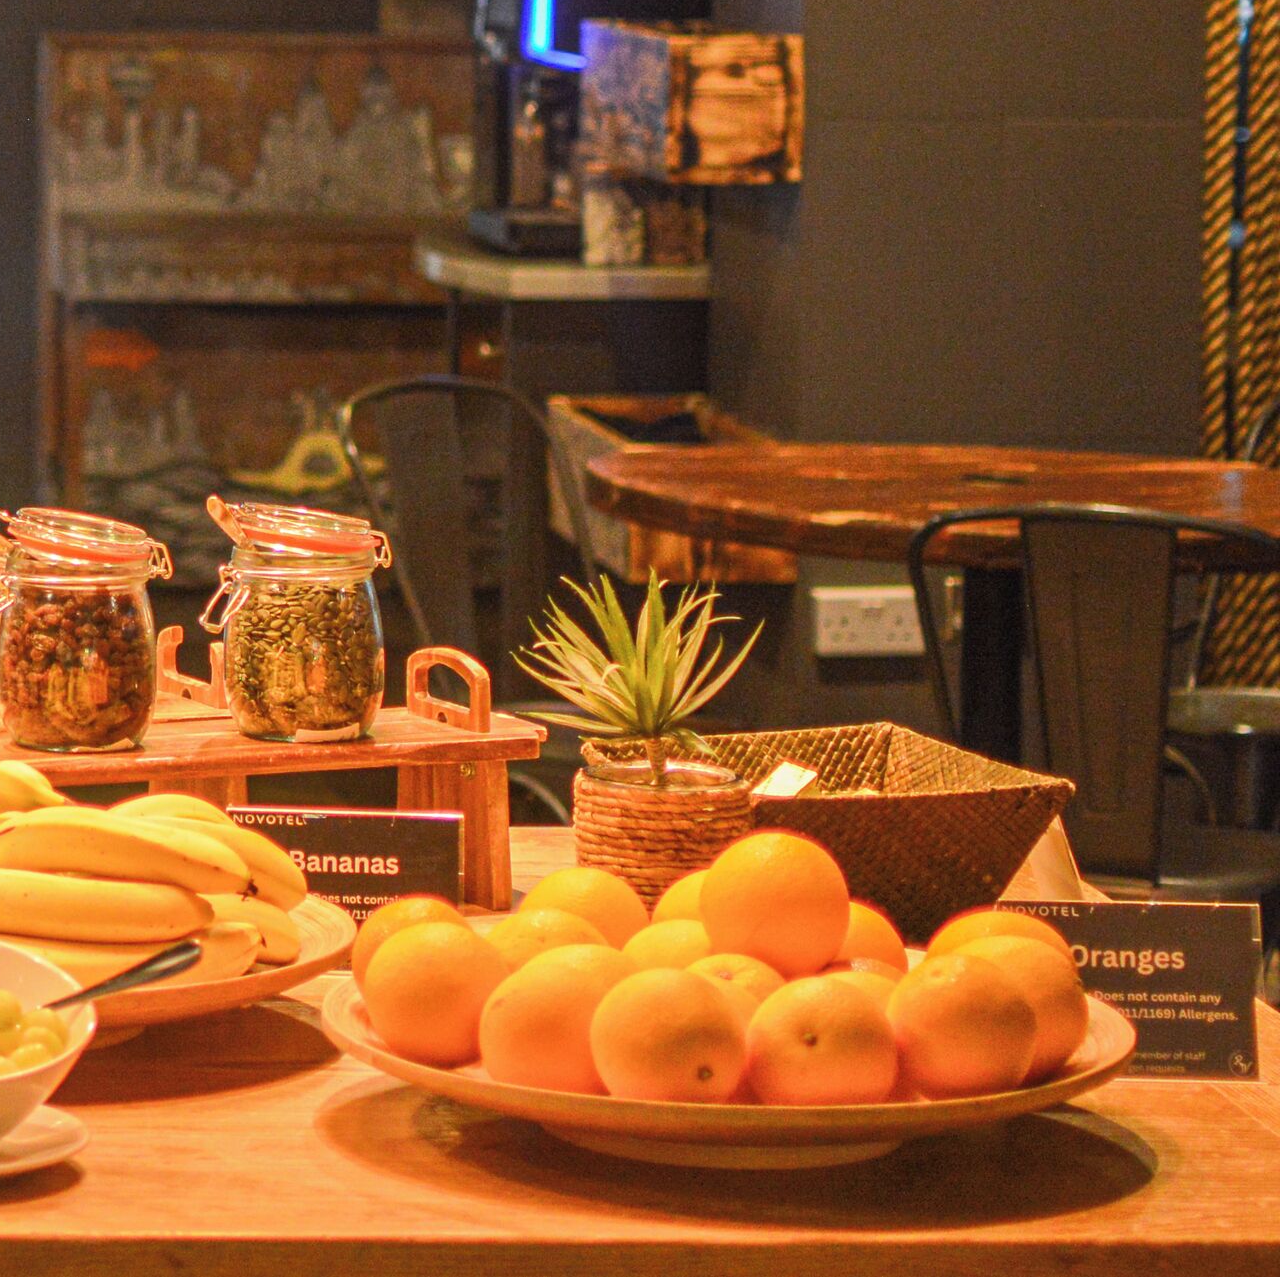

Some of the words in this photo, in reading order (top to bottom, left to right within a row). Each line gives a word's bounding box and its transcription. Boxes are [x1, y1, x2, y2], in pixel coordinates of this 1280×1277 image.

[232, 813, 304, 826] NOVOTEL
[290, 850, 400, 875] Bananas
[342, 894, 362, 904] not
[1002, 905, 1080, 917] NOVOTEL
[1070, 944, 1185, 975] Oranges
[1095, 991, 1125, 1002] Does
[1128, 992, 1148, 1002] not
[1151, 992, 1197, 1003] contain
[1199, 993, 1222, 1006] any
[1178, 1008, 1239, 1023] Allergens.
[1173, 1051, 1183, 1060] of
[1184, 1051, 1206, 1060] staff
